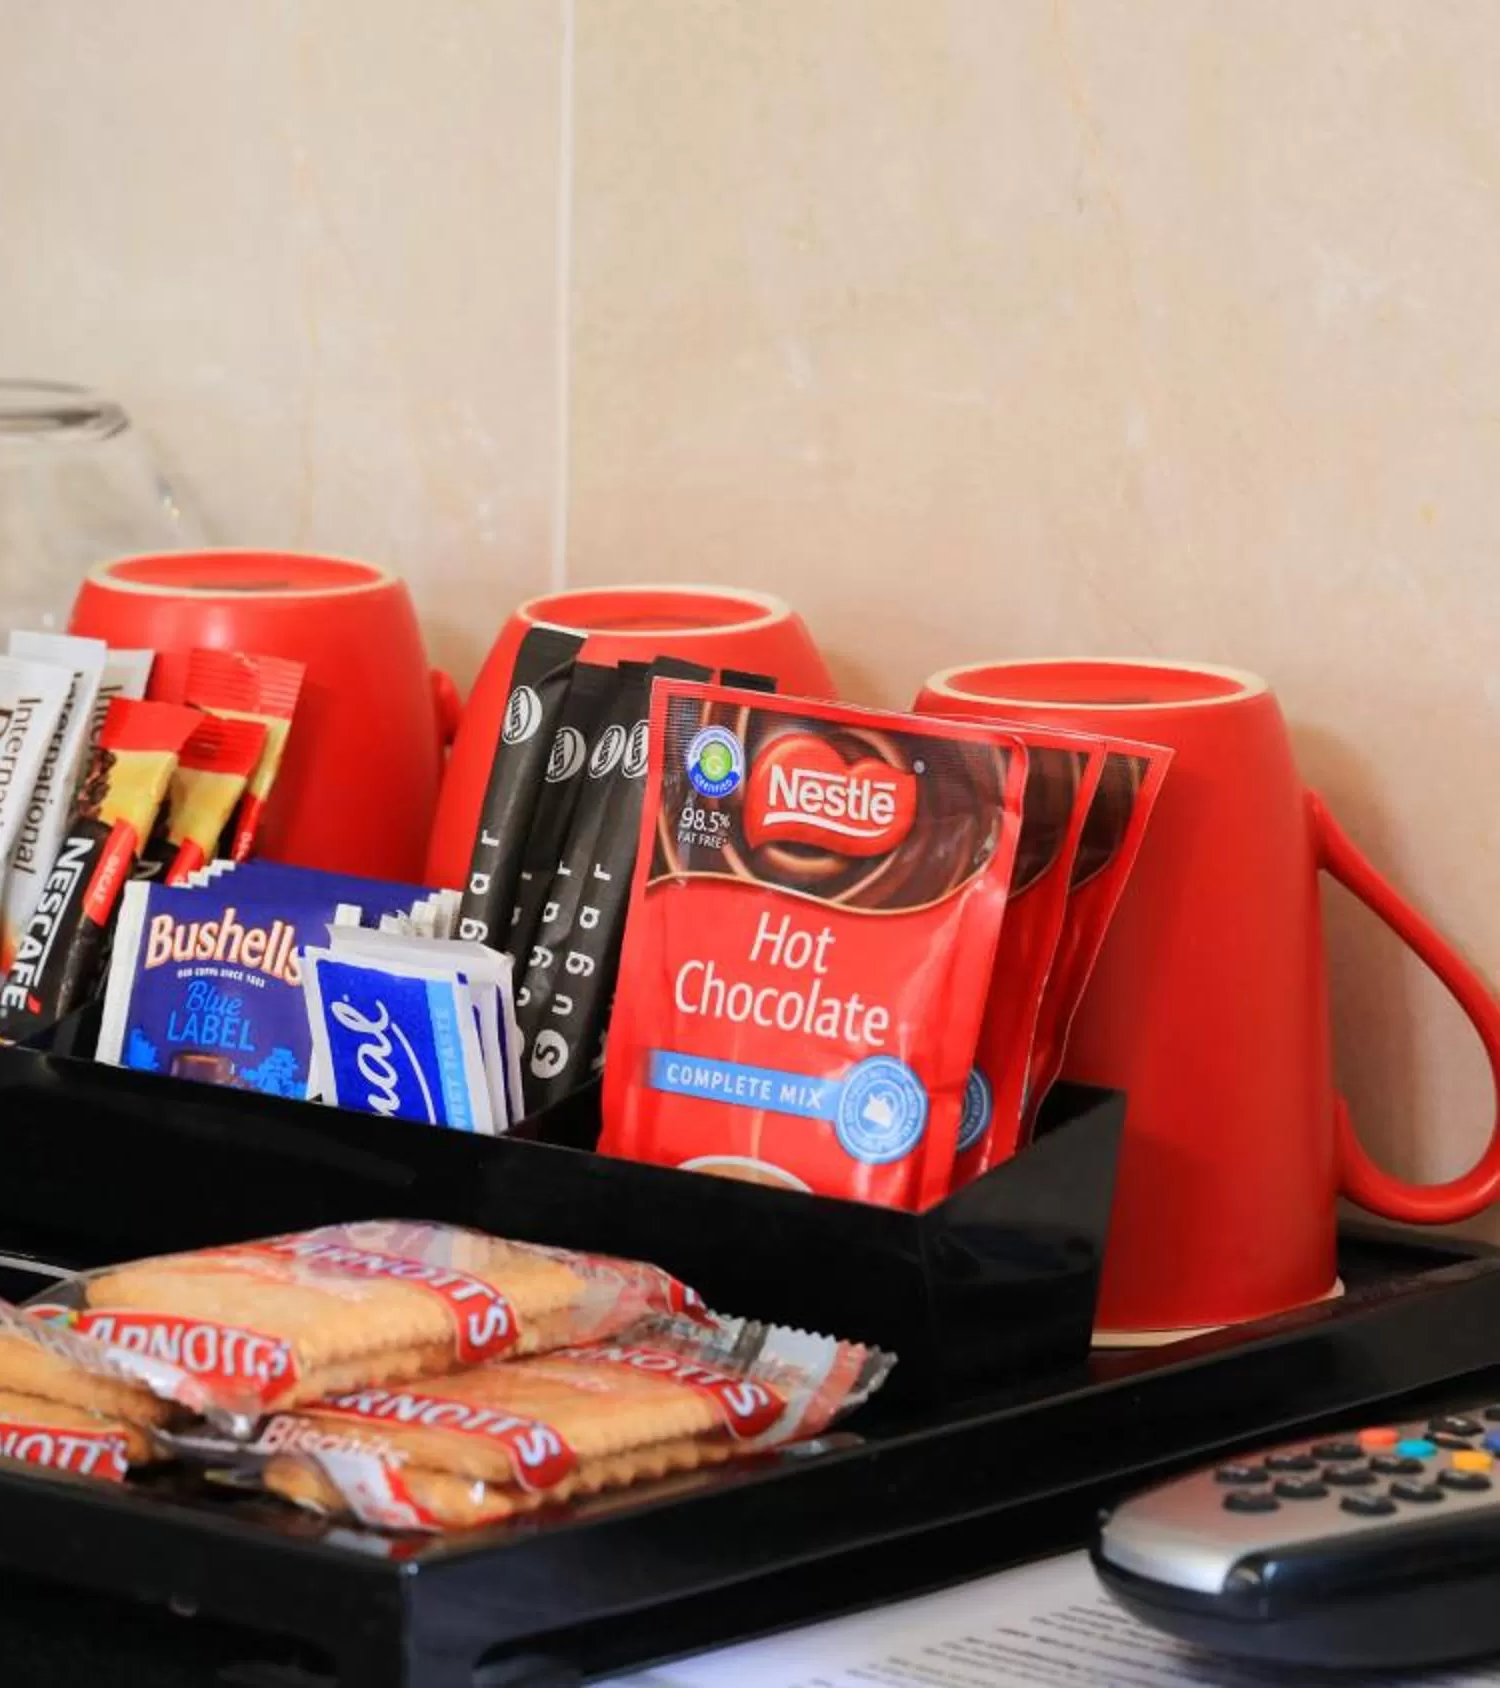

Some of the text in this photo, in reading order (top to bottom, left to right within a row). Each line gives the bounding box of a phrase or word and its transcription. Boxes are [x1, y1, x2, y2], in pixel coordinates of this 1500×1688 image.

[678, 831, 697, 844] FAT
[679, 807, 731, 833] 98.5%
[458, 829, 501, 942] gar
[143, 906, 304, 987] Bushells
[748, 911, 836, 974] Hot
[185, 979, 244, 1017] Blue
[674, 960, 890, 1047] Chocolate
[167, 1009, 256, 1051] LABEL
[666, 1063, 825, 1110] COMPLETE MIX
